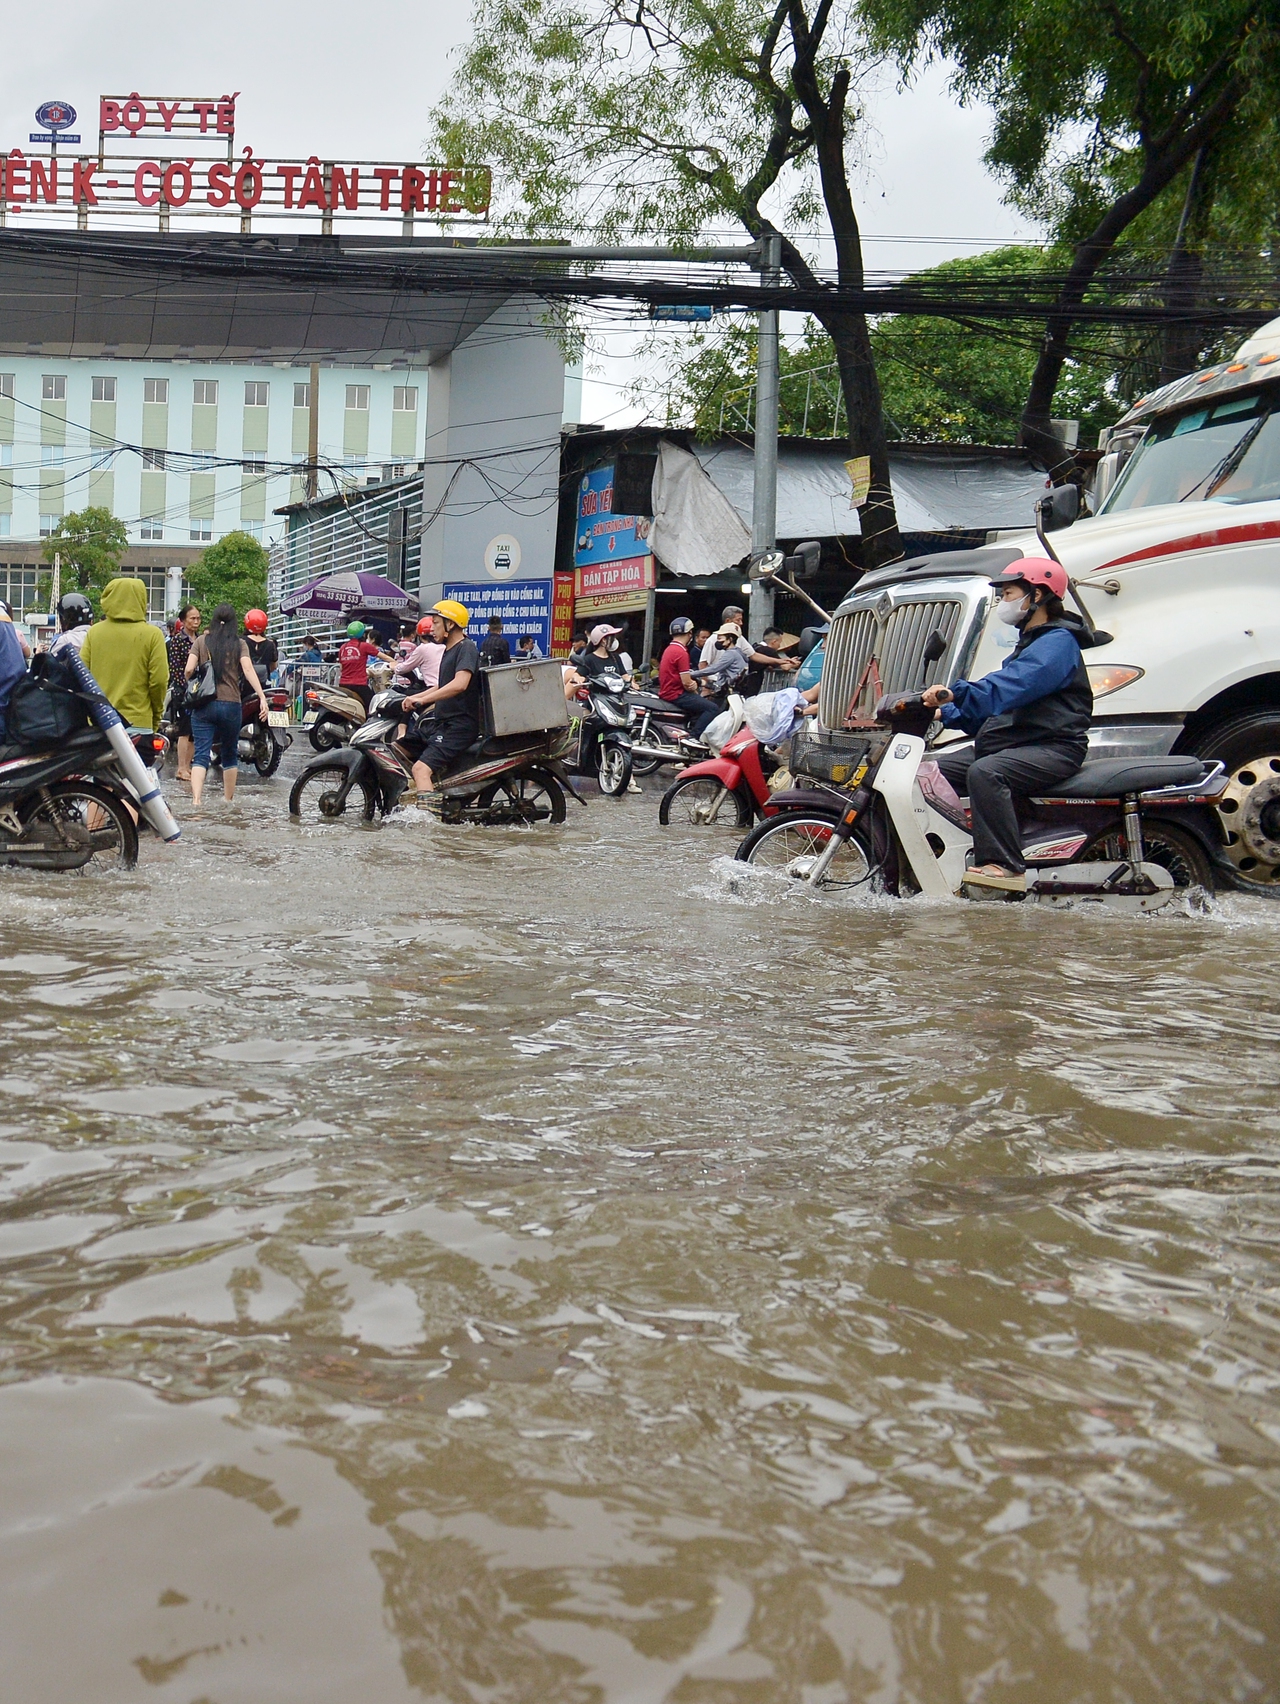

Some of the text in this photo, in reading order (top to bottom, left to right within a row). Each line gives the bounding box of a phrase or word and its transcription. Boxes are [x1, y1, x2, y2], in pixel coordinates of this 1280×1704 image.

[100, 91, 241, 138] BỘ Y TẾ
[73, 162, 99, 205] K
[134, 157, 195, 208] CƠ
[206, 145, 265, 209] SỞ
[277, 155, 359, 211] TÂN
[581, 488, 598, 518] SỮA
[592, 520, 604, 537] BÁN
[605, 517, 622, 535] TRONG
[583, 564, 640, 587] BÁN TẠP HÓA
[327, 592, 335, 600] 33
[335, 593, 347, 601] 533
[347, 594, 359, 604] 533
[385, 598, 395, 606] 533
[556, 584, 572, 602] PHỤ
[516, 607, 519, 617] 2
